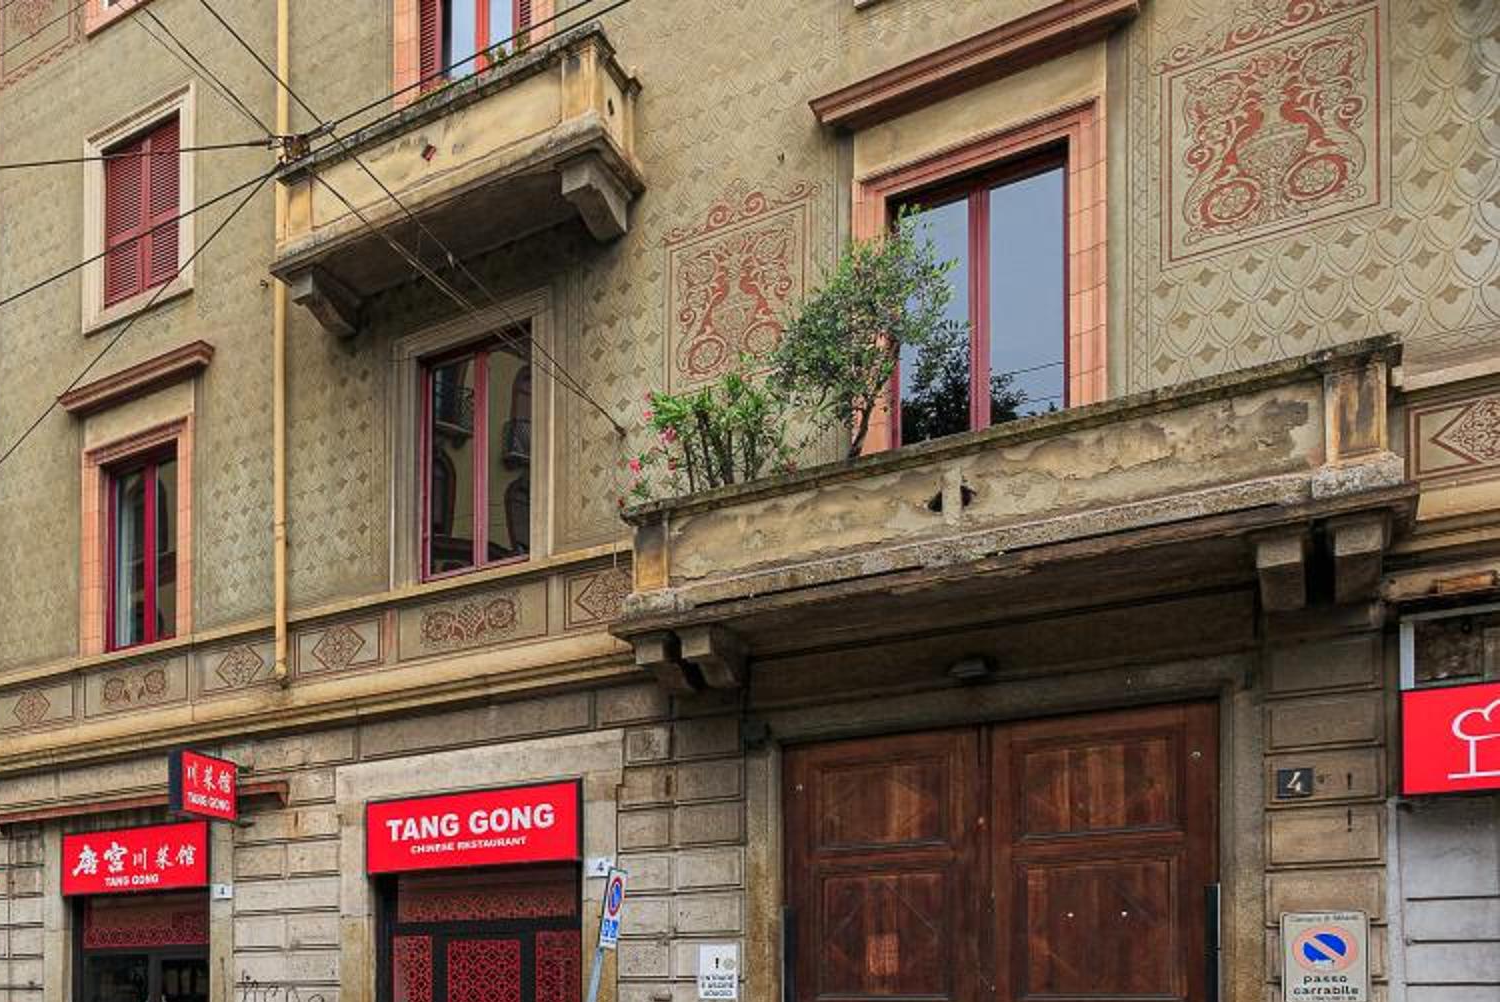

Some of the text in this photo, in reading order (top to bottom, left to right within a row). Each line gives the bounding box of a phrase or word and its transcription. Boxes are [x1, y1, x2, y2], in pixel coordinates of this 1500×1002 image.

[1286, 771, 1302, 792] 4
[385, 803, 555, 842] TANG GONG
[411, 836, 527, 855] CHINESE RESTAURANT
[104, 873, 159, 887] TANG GONG
[1303, 975, 1348, 984] passo
[1293, 985, 1359, 995] carrabile
